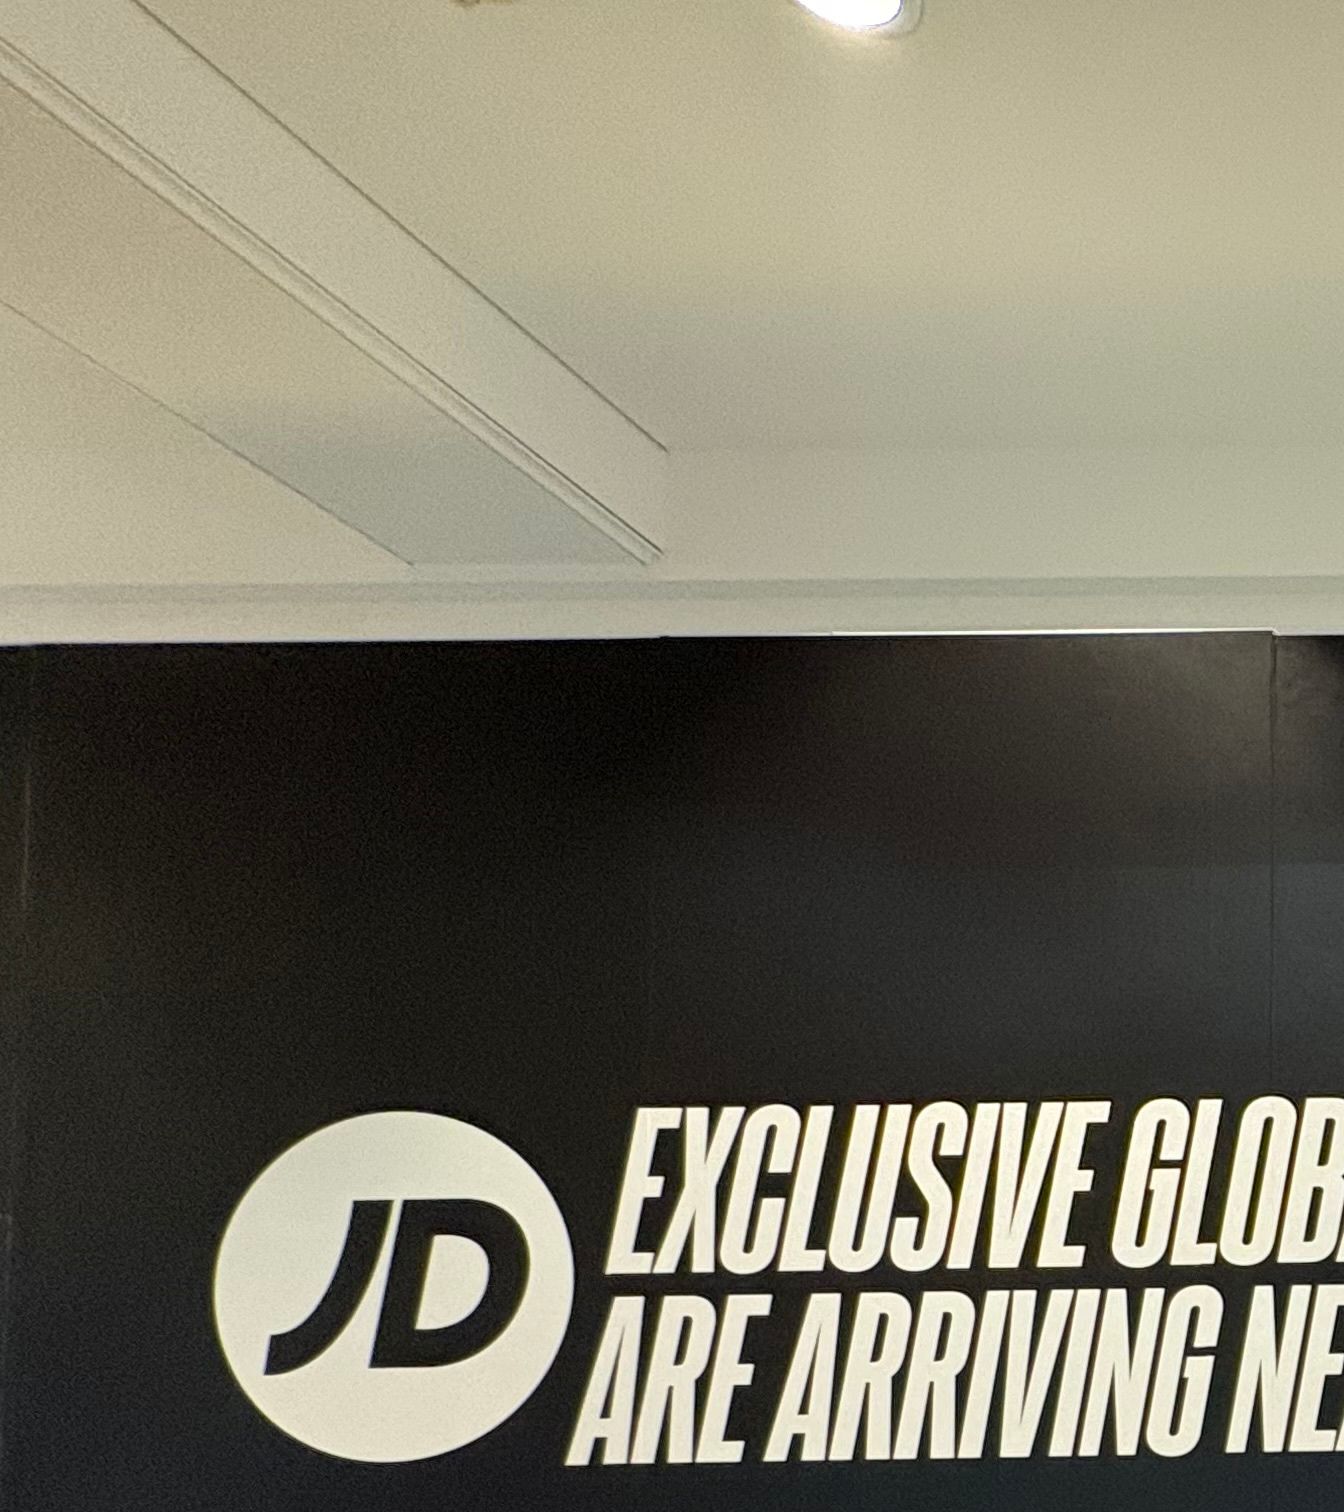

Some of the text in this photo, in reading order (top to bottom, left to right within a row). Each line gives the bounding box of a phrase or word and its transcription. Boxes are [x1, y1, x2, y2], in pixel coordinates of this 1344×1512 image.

[605, 1101, 1111, 1276] EXCLUSIVE
[263, 1198, 531, 1376] JD
[565, 1293, 772, 1466] ARE
[763, 1285, 1223, 1463] ARRIVING
